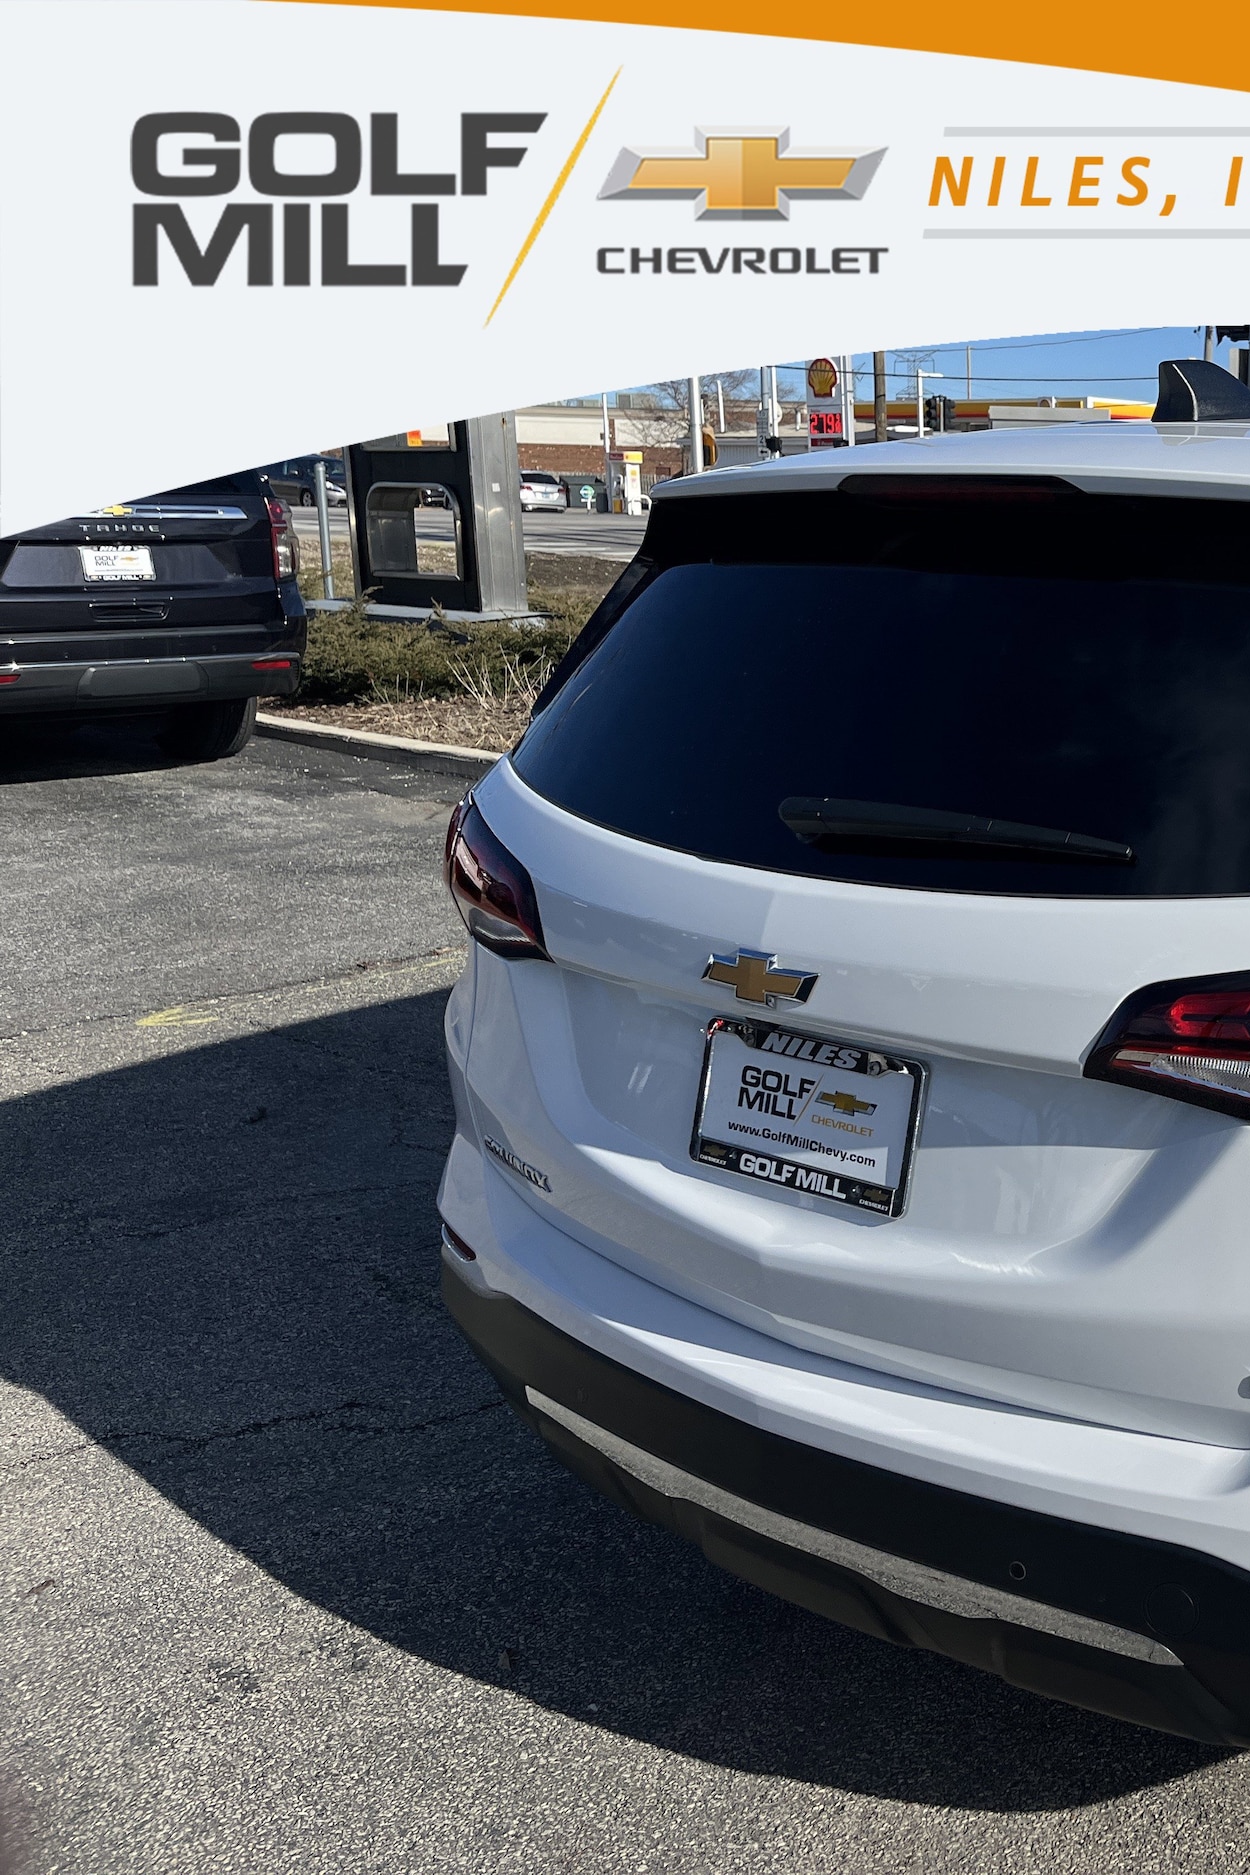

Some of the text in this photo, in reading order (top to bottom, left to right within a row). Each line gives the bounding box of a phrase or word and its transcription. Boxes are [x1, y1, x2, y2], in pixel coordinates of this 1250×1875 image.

[79, 524, 160, 532] TAHOE
[760, 1031, 862, 1070] NILES
[741, 1065, 816, 1100] GOLF
[737, 1086, 797, 1121] MILL
[811, 1113, 875, 1138] CHEVROLET
[728, 1120, 876, 1168] www.GolfMillChevy.com
[739, 1153, 847, 1200] GOLF MILL
